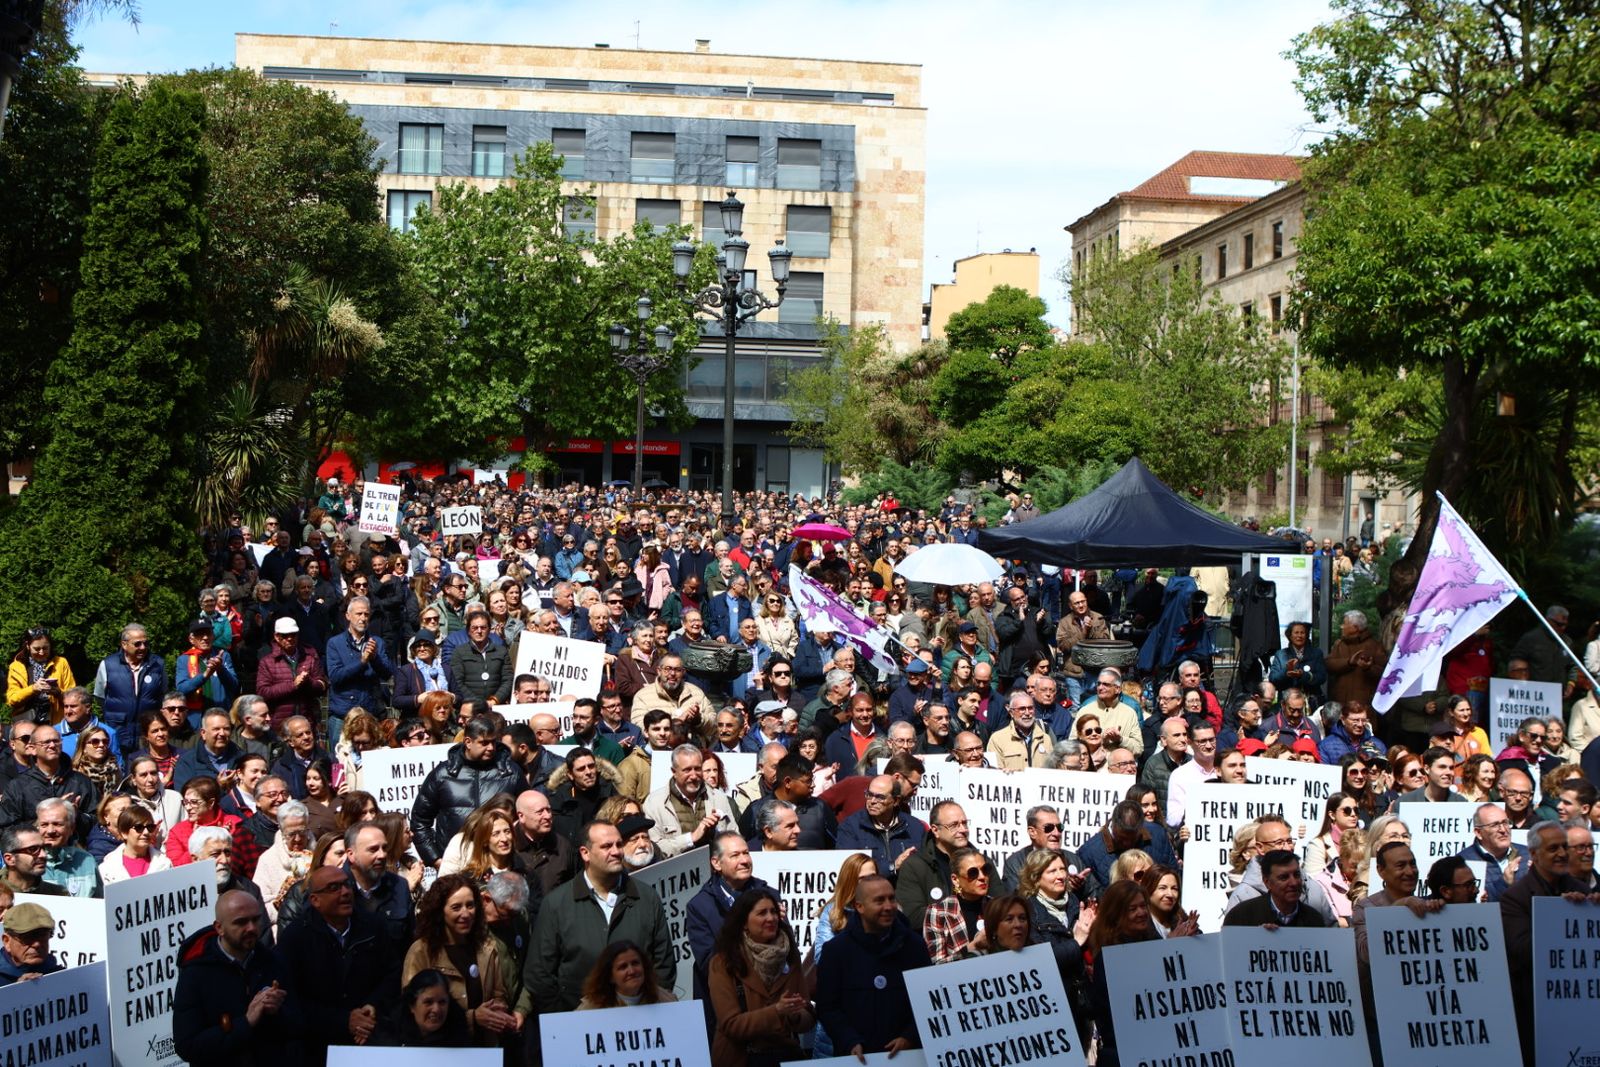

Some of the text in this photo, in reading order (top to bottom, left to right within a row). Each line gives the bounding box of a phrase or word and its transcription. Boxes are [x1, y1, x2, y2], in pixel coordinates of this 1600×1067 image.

[364, 502, 374, 510] DE
[366, 490, 398, 501] EL TREN
[367, 512, 389, 523] A LA
[442, 509, 480, 529] LEÓN
[554, 645, 569, 661] NI
[529, 659, 589, 681] AISLADOS
[550, 681, 564, 695] NI
[1508, 687, 1544, 701] MIRA LA
[1499, 703, 1550, 716] ASISTENCIA
[391, 762, 425, 779] MIRA
[1039, 784, 1120, 807] TREN RUTA
[1304, 779, 1330, 800] NOS
[990, 807, 1007, 824] NO
[1201, 801, 1285, 819] TREN RUTA
[1301, 801, 1318, 821] EN
[1194, 824, 1234, 843] DE LA
[1423, 817, 1460, 834] RENFE
[652, 867, 700, 899] ITAN
[778, 871, 838, 895] MENOS
[115, 884, 208, 932] SALAMANCA
[140, 921, 185, 956] NO ES
[1383, 926, 1490, 955] RENFE NOS
[1565, 919, 1580, 939] LA
[1162, 951, 1187, 982] NI
[1250, 949, 1333, 973] PORTUGAL
[1549, 949, 1566, 969] DE
[1573, 949, 1588, 969] LA
[1400, 958, 1479, 986] DEJA EN
[928, 968, 1043, 1012] NI EXCUSAS
[1235, 977, 1352, 1007] ESTÁ AL LADO,
[1426, 985, 1462, 1016] VÍA
[1546, 979, 1581, 1000] PARA
[1135, 982, 1227, 1021] AISLADOS
[2, 992, 89, 1038] DIGNIDAD
[927, 993, 1059, 1039] NI RETRASOS:
[1240, 1009, 1355, 1037] EL TREN NO
[585, 1027, 666, 1055] LA RUTA
[1174, 1017, 1200, 1049] NI
[1407, 1018, 1491, 1049] MUERTA
[0, 1023, 102, 1067] ALAMANCA
